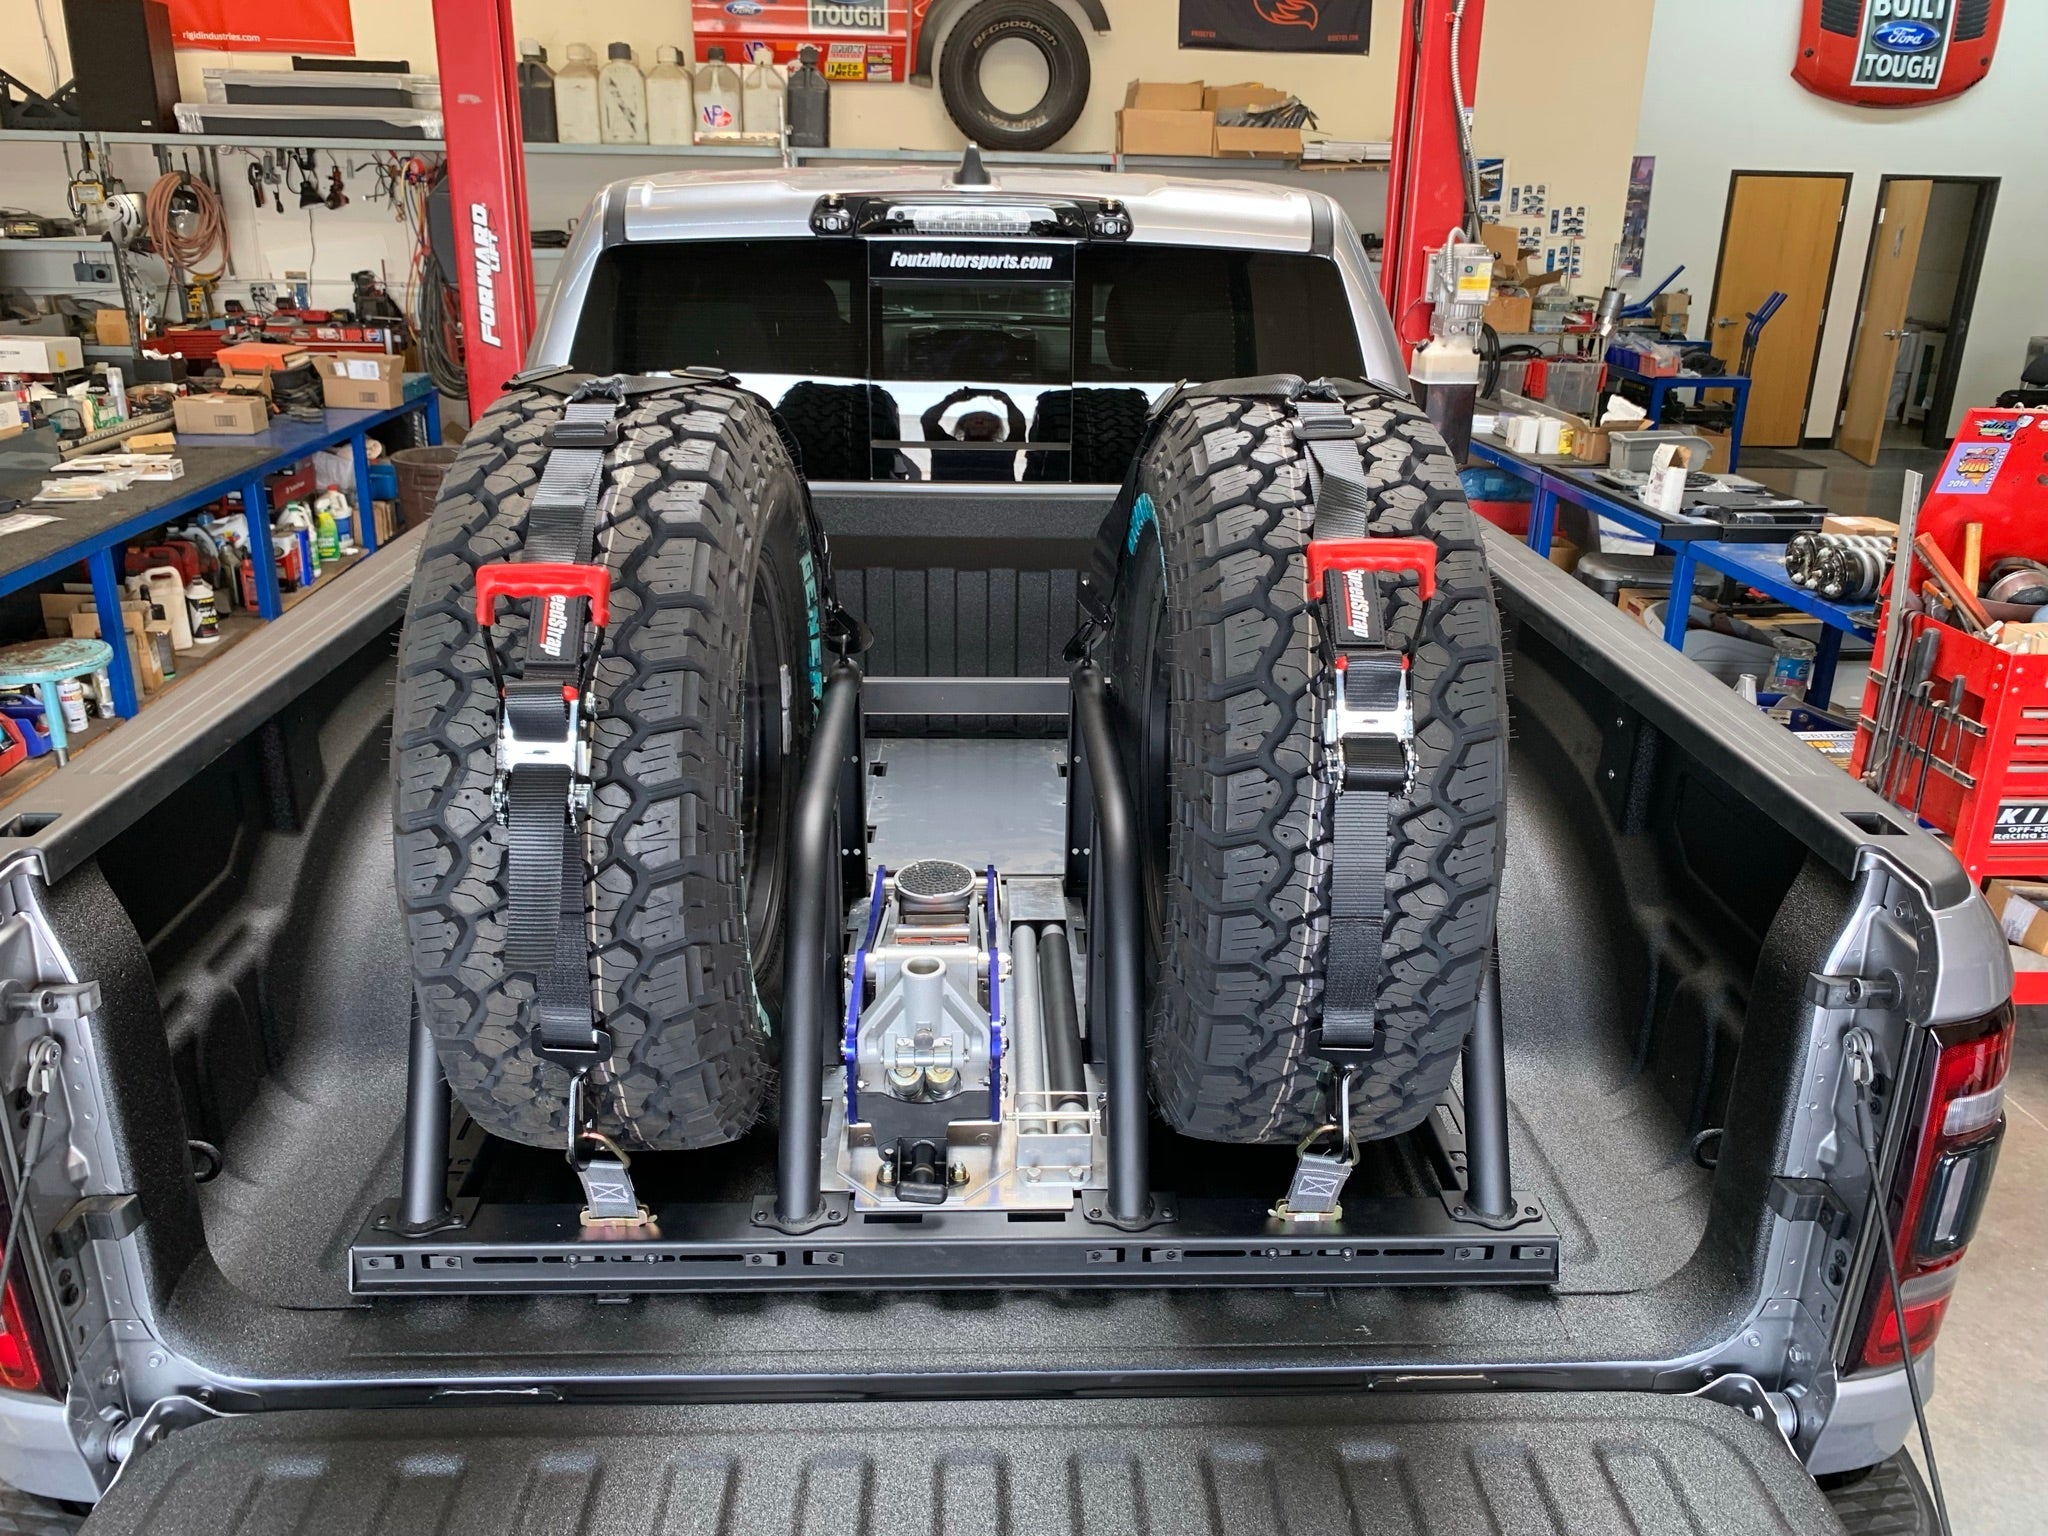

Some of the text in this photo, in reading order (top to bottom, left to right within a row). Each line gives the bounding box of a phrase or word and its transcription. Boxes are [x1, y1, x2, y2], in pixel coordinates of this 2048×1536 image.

[813, 4, 882, 27] TOUGH
[182, 30, 260, 42] rigidindustries.com
[972, 20, 1058, 49] BFGoodrich
[1887, 27, 1923, 45] Ford
[1864, 53, 1938, 79] TOUGH
[889, 251, 1054, 270] FoutzMotorsports.com
[470, 203, 502, 348] FORWARD
[1947, 480, 1969, 488] 2014
[540, 594, 568, 657] eedStrap
[799, 551, 823, 728] GENERA
